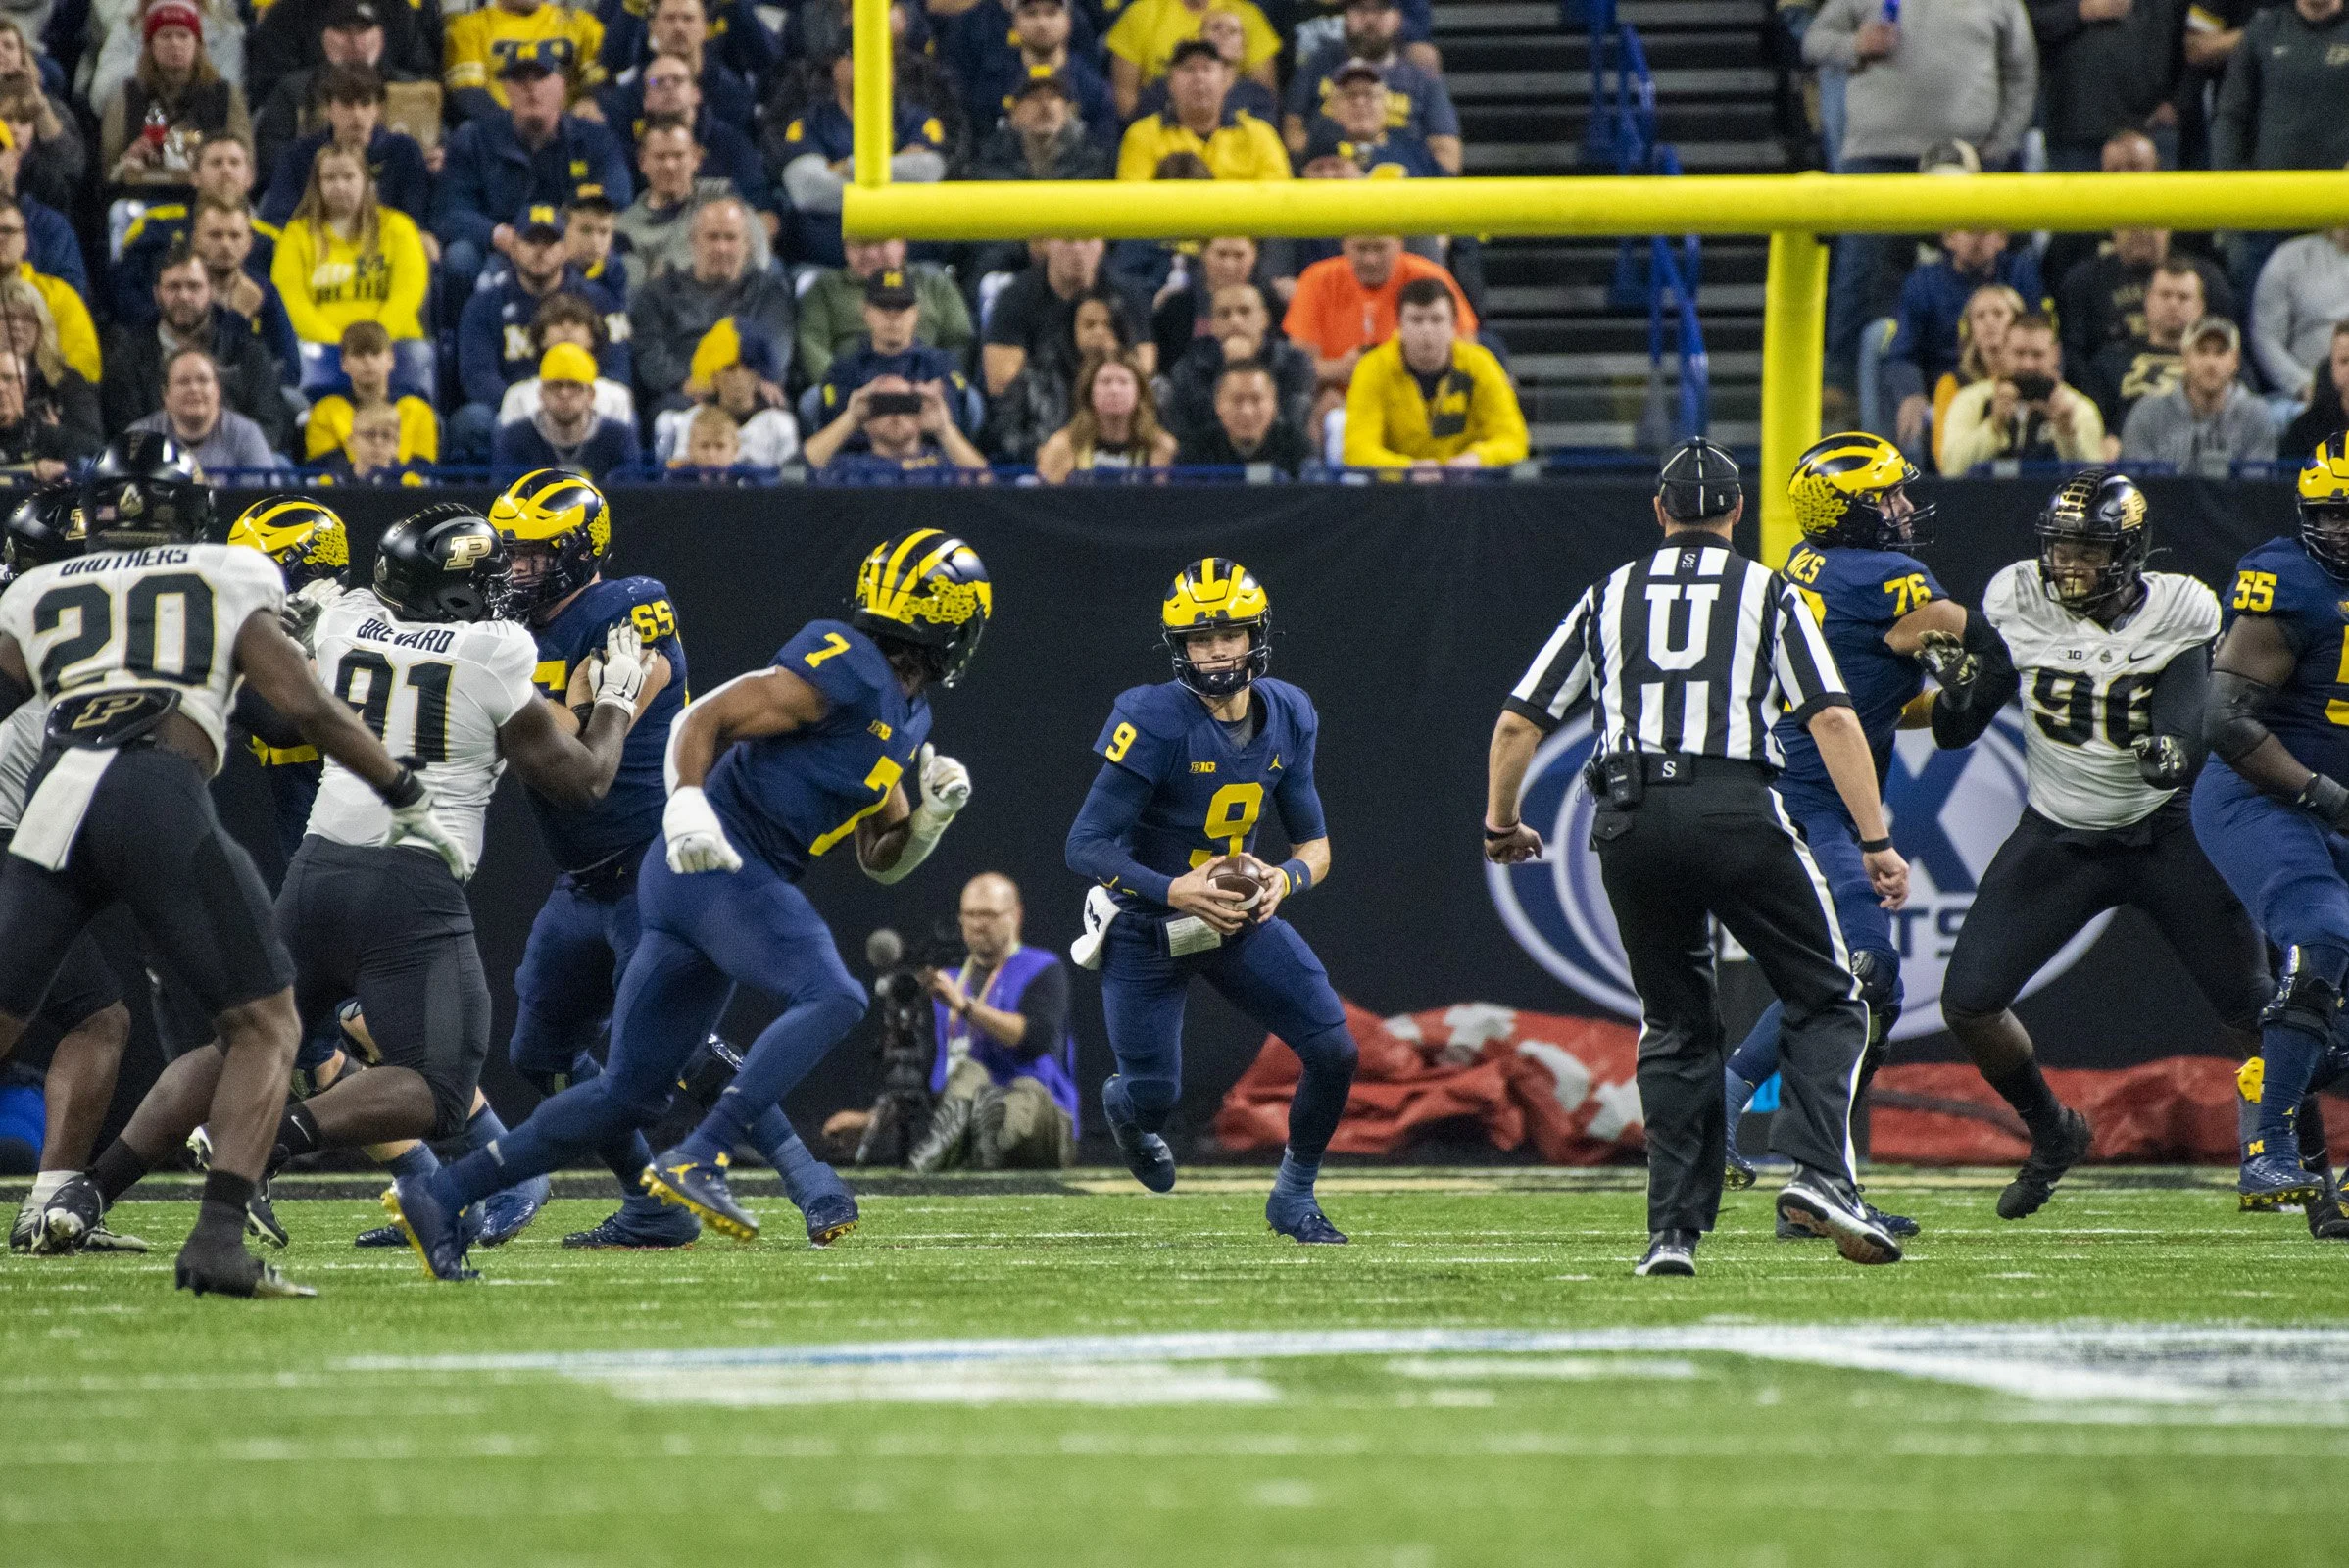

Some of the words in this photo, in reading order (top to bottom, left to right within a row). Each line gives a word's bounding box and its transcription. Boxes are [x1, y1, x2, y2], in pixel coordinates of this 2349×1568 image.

[444, 536, 491, 571] P
[1884, 573, 1933, 617] 76
[2231, 570, 2277, 612] 55
[33, 572, 216, 693] 20
[356, 617, 456, 654] BREVARD
[630, 599, 675, 643] 65
[1645, 584, 1721, 671] U
[804, 632, 851, 668] 7
[335, 648, 457, 763] 91
[1105, 721, 1138, 763] 9
[808, 755, 904, 857] 7
[1188, 781, 1264, 871] 9
